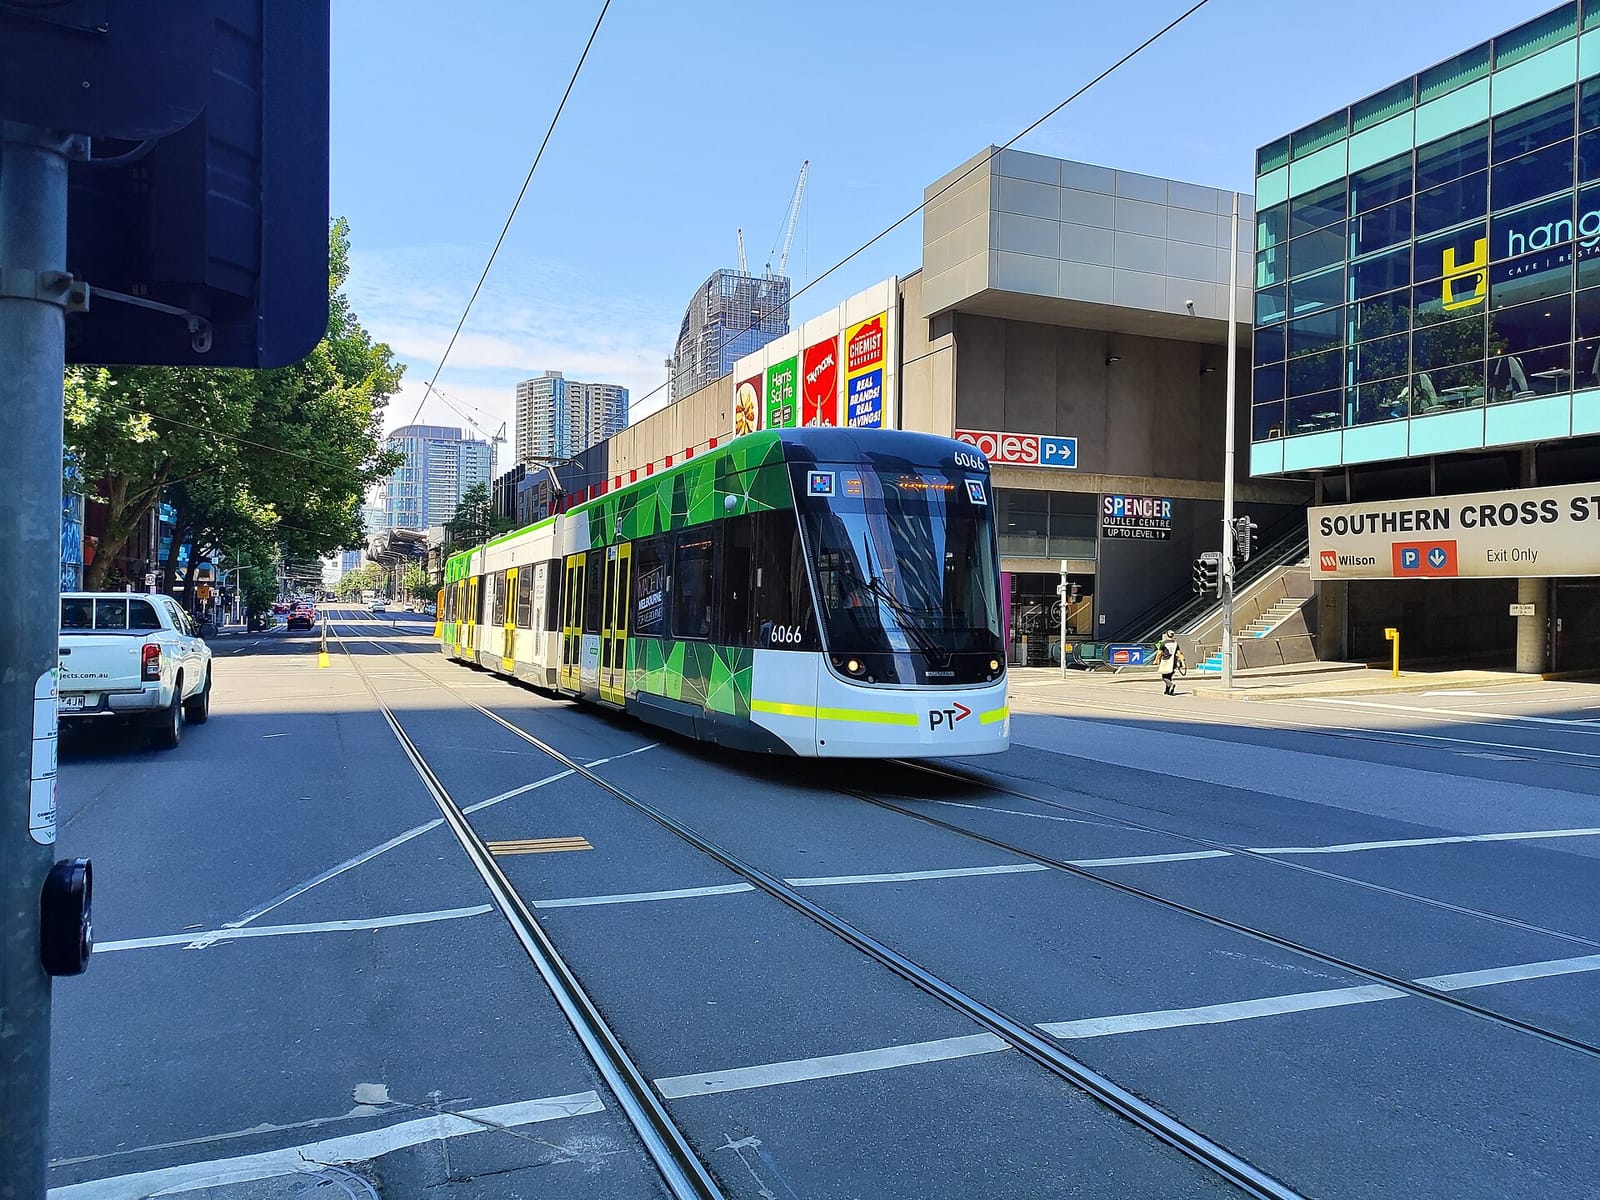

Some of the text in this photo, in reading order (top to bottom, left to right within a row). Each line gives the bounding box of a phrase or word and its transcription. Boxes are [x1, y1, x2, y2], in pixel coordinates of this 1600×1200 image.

[1508, 263, 1537, 275] CAFE
[849, 333, 881, 358] CHEMIST
[849, 350, 881, 367] WAREHOUSE
[771, 368, 792, 388] Harris
[856, 376, 873, 391] REAL
[850, 386, 881, 406] BRANDS!
[855, 401, 873, 416] REAL
[848, 409, 881, 427] SAVINGS!
[1045, 444, 1057, 459] P
[954, 451, 985, 471] 6066
[1103, 497, 1171, 518] SPENCER
[1320, 496, 1600, 536] SOUTHERN CROSS ST
[1103, 516, 1170, 528] OUTLET CENTRE
[1107, 528, 1119, 537] UP
[1120, 529, 1131, 537] TO
[1131, 530, 1154, 539] LEVEL
[1338, 551, 1416, 566] Wilson P
[1487, 548, 1538, 563] Exit Only
[638, 591, 662, 610] MELBOURNE
[771, 625, 802, 643] 6066
